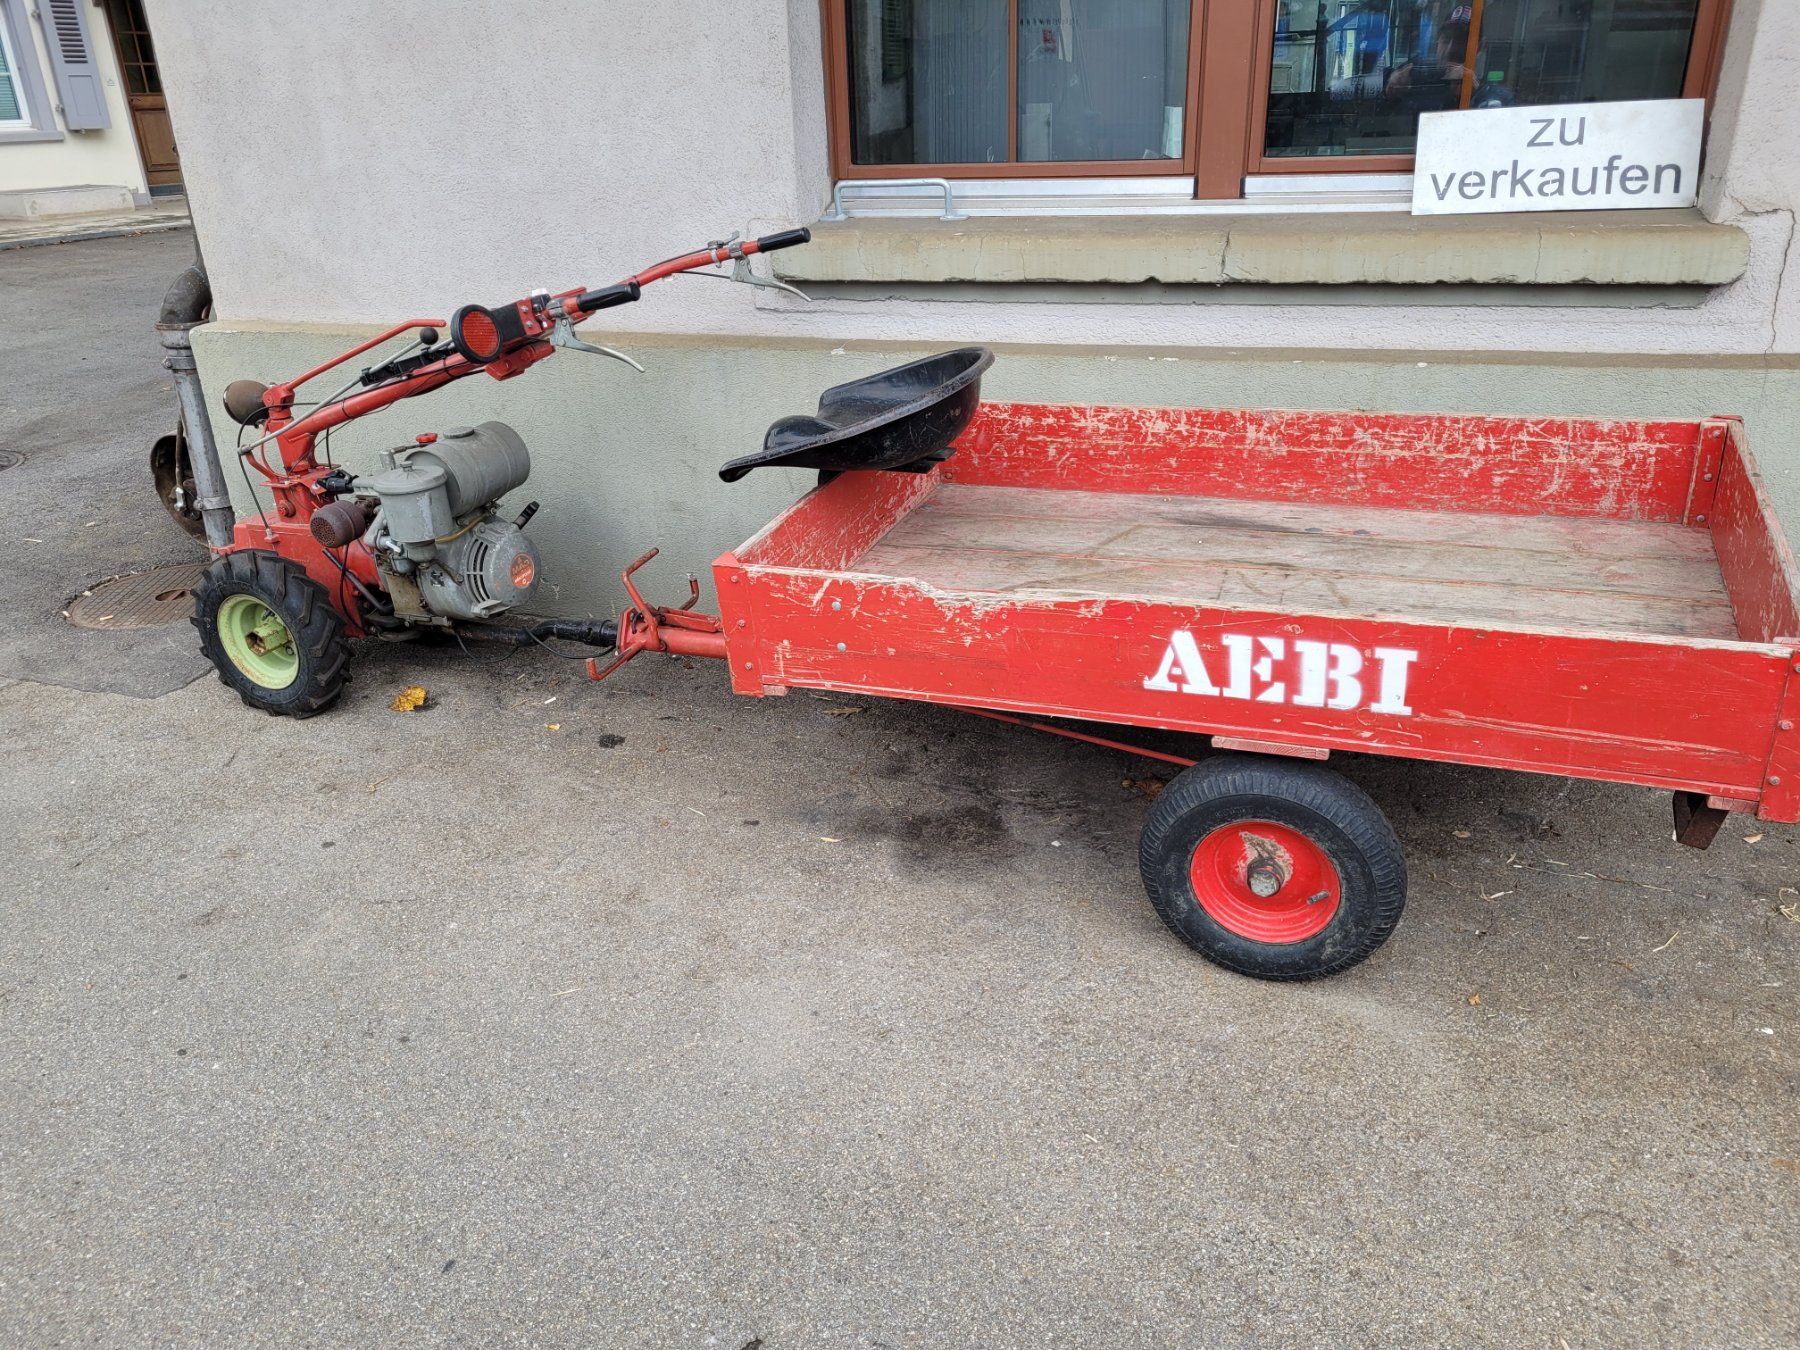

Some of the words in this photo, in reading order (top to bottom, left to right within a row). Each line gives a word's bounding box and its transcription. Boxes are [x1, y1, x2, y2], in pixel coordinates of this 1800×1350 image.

[1527, 116, 1586, 147] zu
[1430, 154, 1682, 200] verkaufen
[1142, 629, 1419, 716] AEBI
